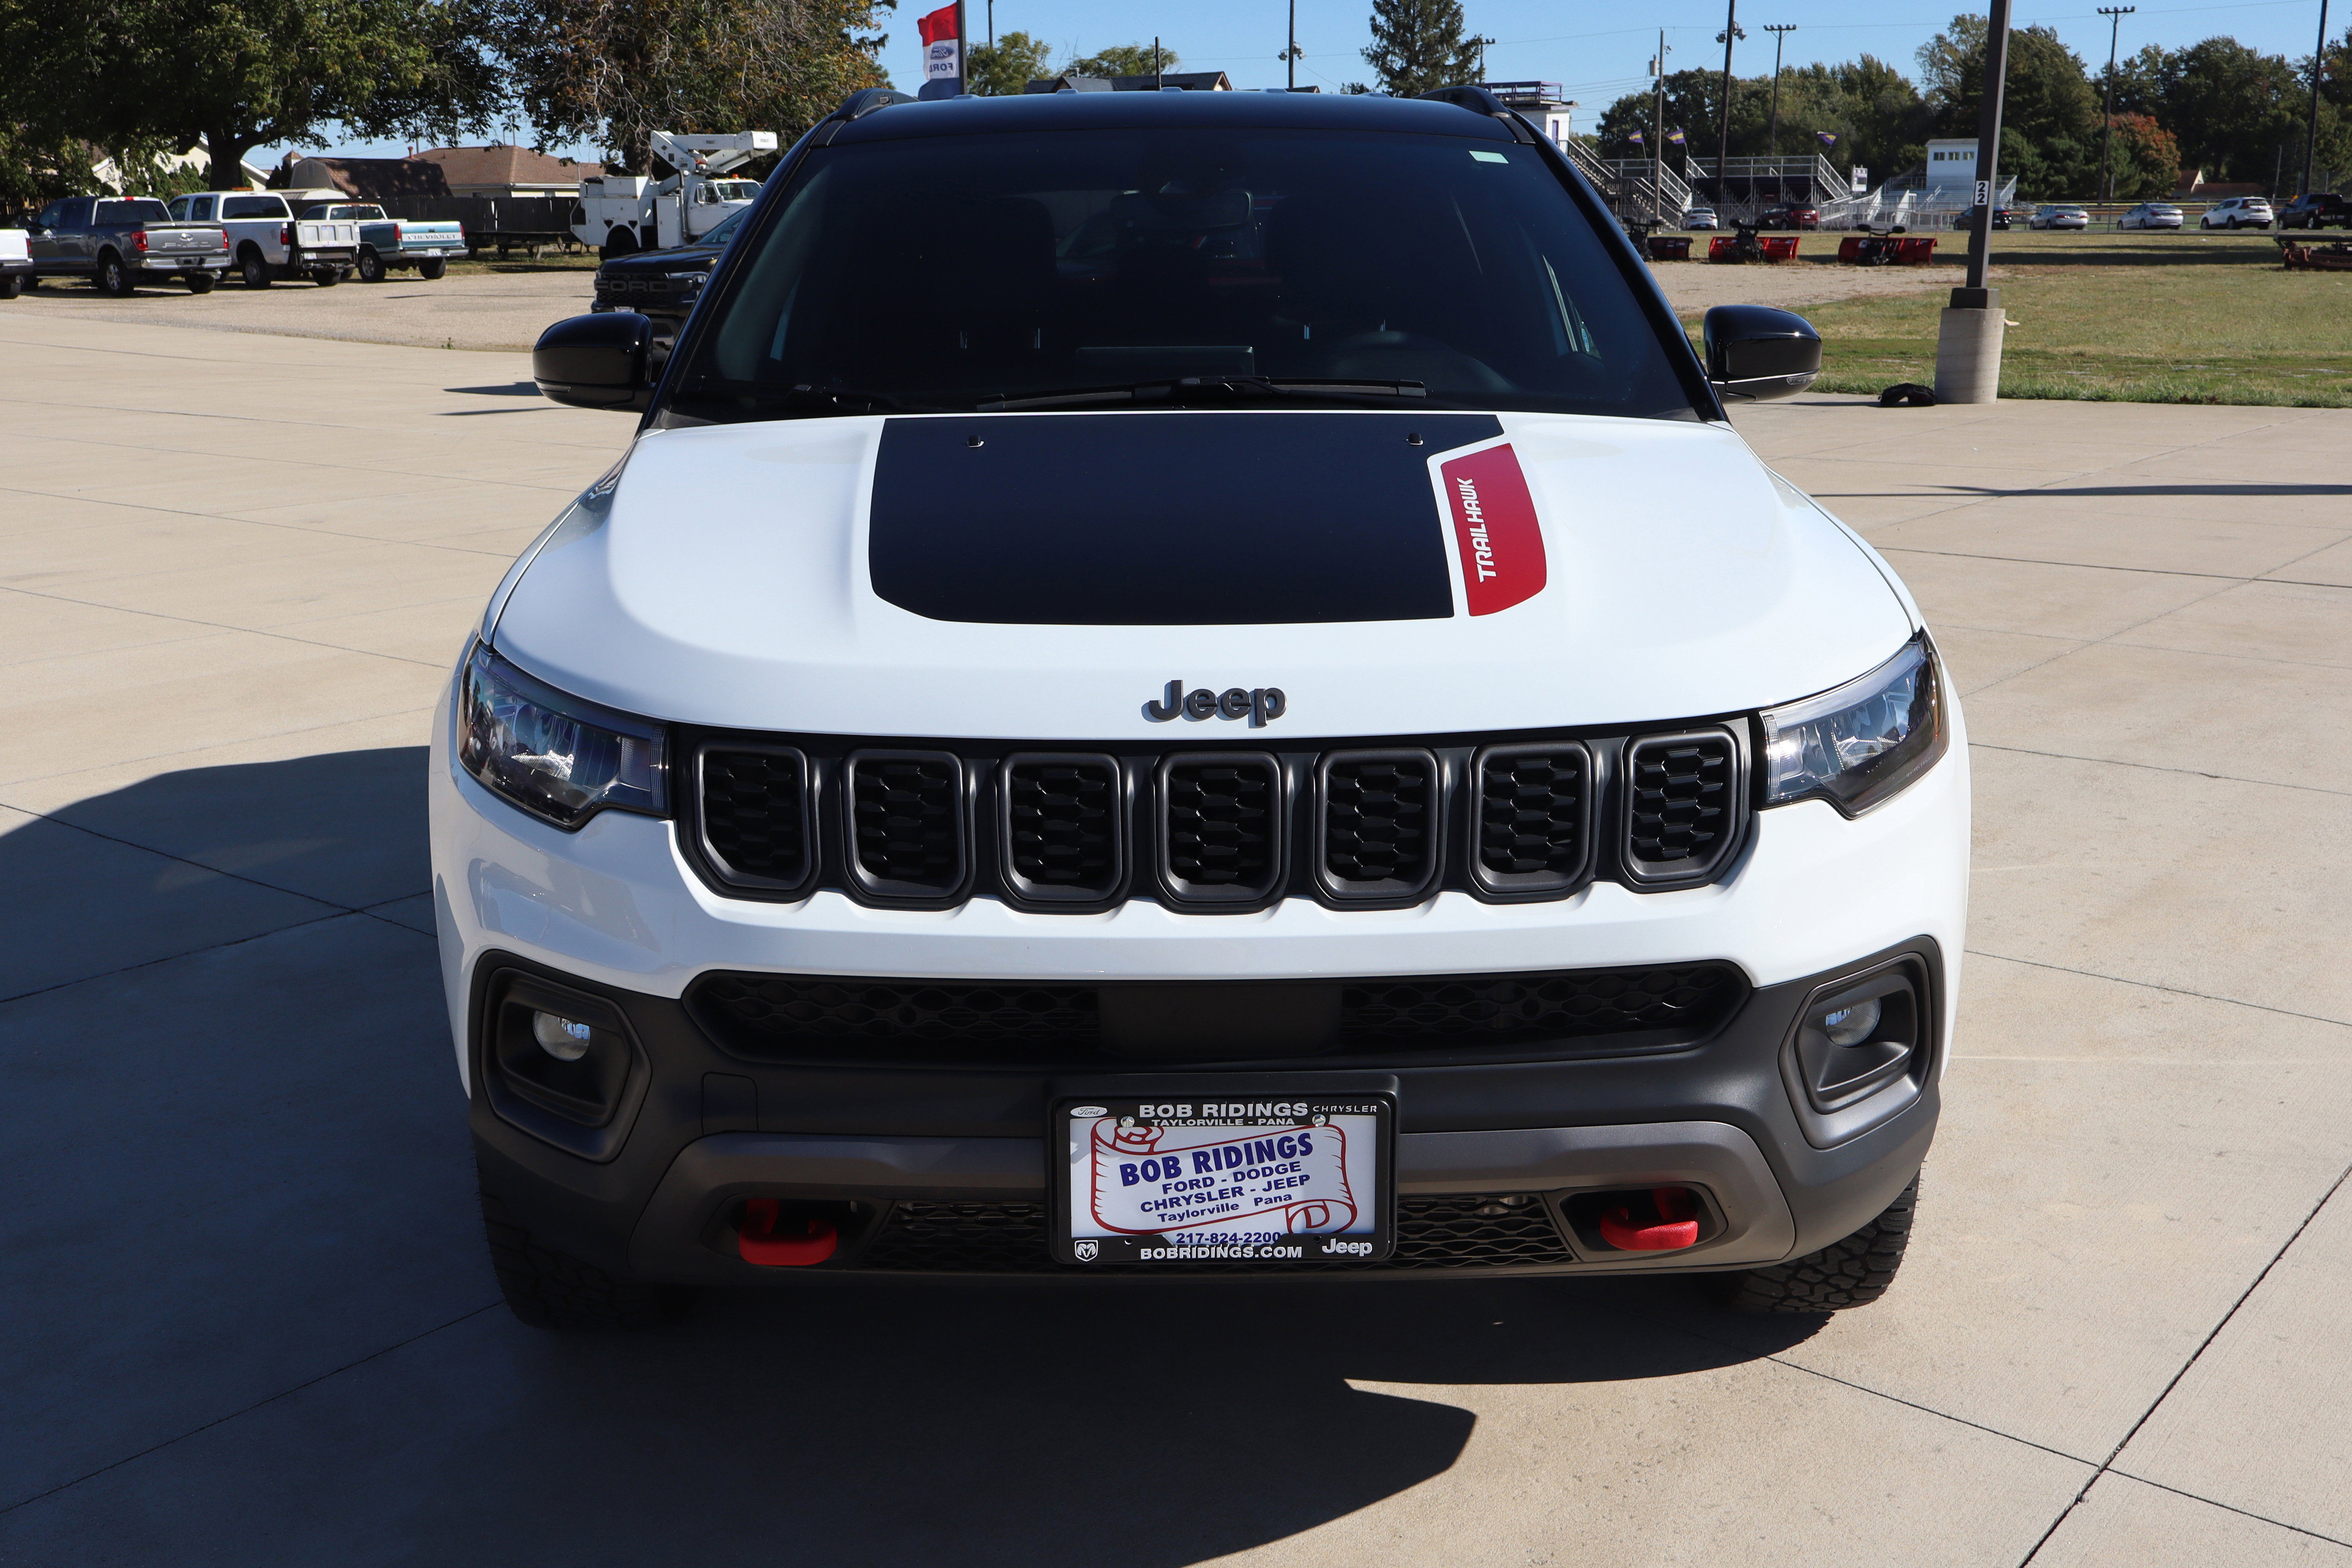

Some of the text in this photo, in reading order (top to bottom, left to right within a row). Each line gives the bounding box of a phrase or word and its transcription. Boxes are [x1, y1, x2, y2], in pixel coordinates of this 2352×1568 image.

[595, 279, 671, 292] FORD
[1456, 477, 1497, 583] TRAILHAWK
[1148, 679, 1287, 726] Jeep
[1139, 1102, 1308, 1118] BOB RIDINGS
[1151, 1118, 1244, 1127] TAYLORVILLE
[1258, 1118, 1295, 1126] PANA
[1119, 1132, 1313, 1187] BOB RIDINGS
[1162, 1176, 1215, 1195] FORD
[1232, 1160, 1302, 1183] DODGE
[1140, 1186, 1245, 1212] CHRYSLER
[1262, 1174, 1310, 1192] JEEP
[1157, 1194, 1292, 1223] Taylorville Pana
[1176, 1232, 1281, 1244] 217-824-2200
[1321, 1238, 1373, 1257] Jeep
[1140, 1246, 1302, 1260] BOBRIDINGS.COM
